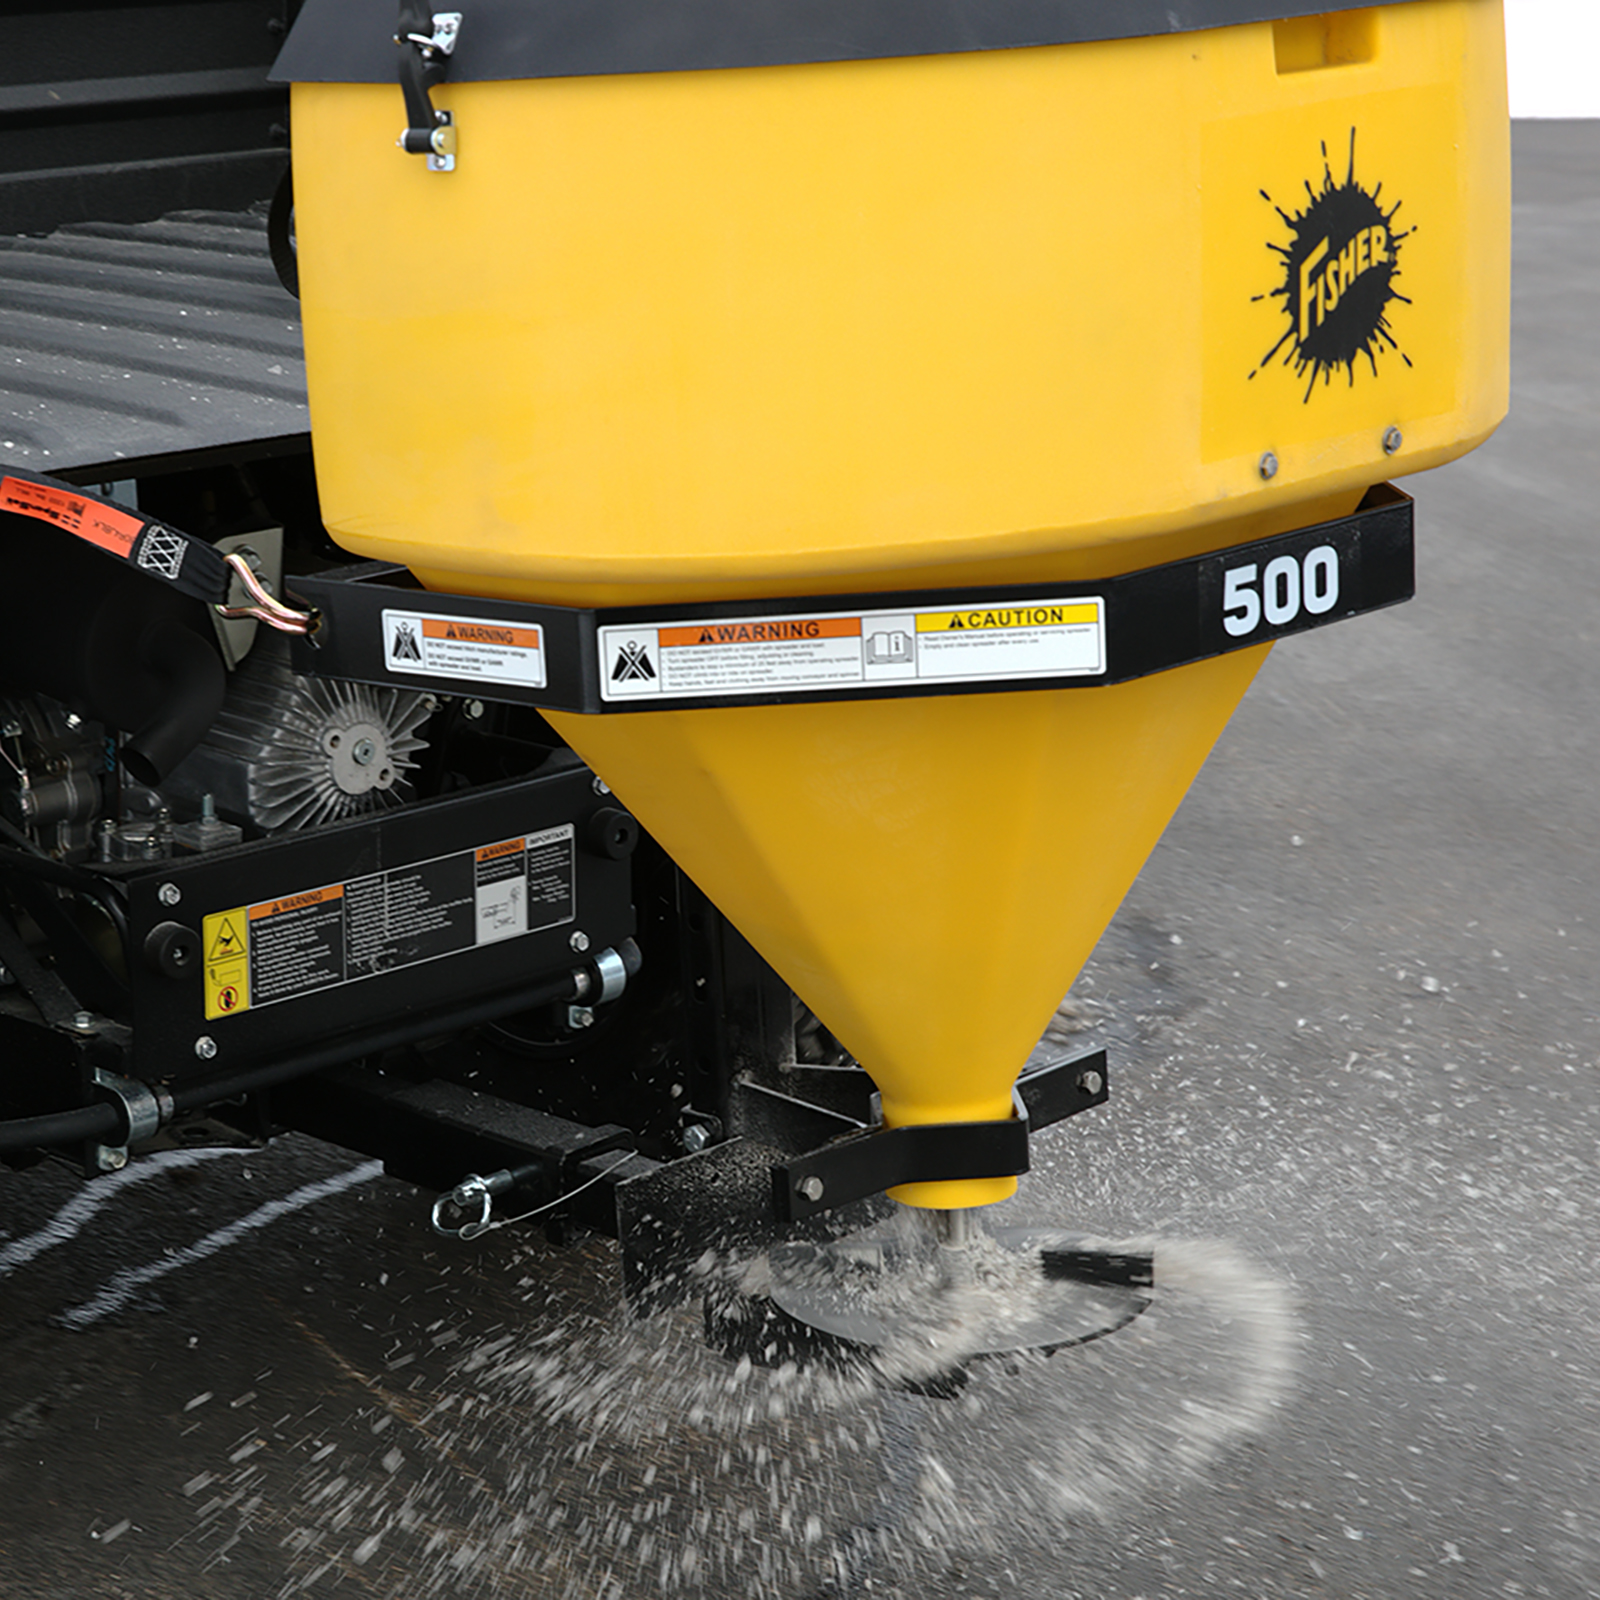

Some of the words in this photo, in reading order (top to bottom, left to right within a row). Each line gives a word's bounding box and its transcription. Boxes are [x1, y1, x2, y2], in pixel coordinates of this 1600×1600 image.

[1298, 224, 1389, 343] FISHER
[1223, 545, 1339, 637] 500
[968, 609, 1064, 627] CAUTION
[457, 626, 513, 643] WARNING
[717, 621, 820, 640] WARNING
[282, 891, 323, 909] WARNING
